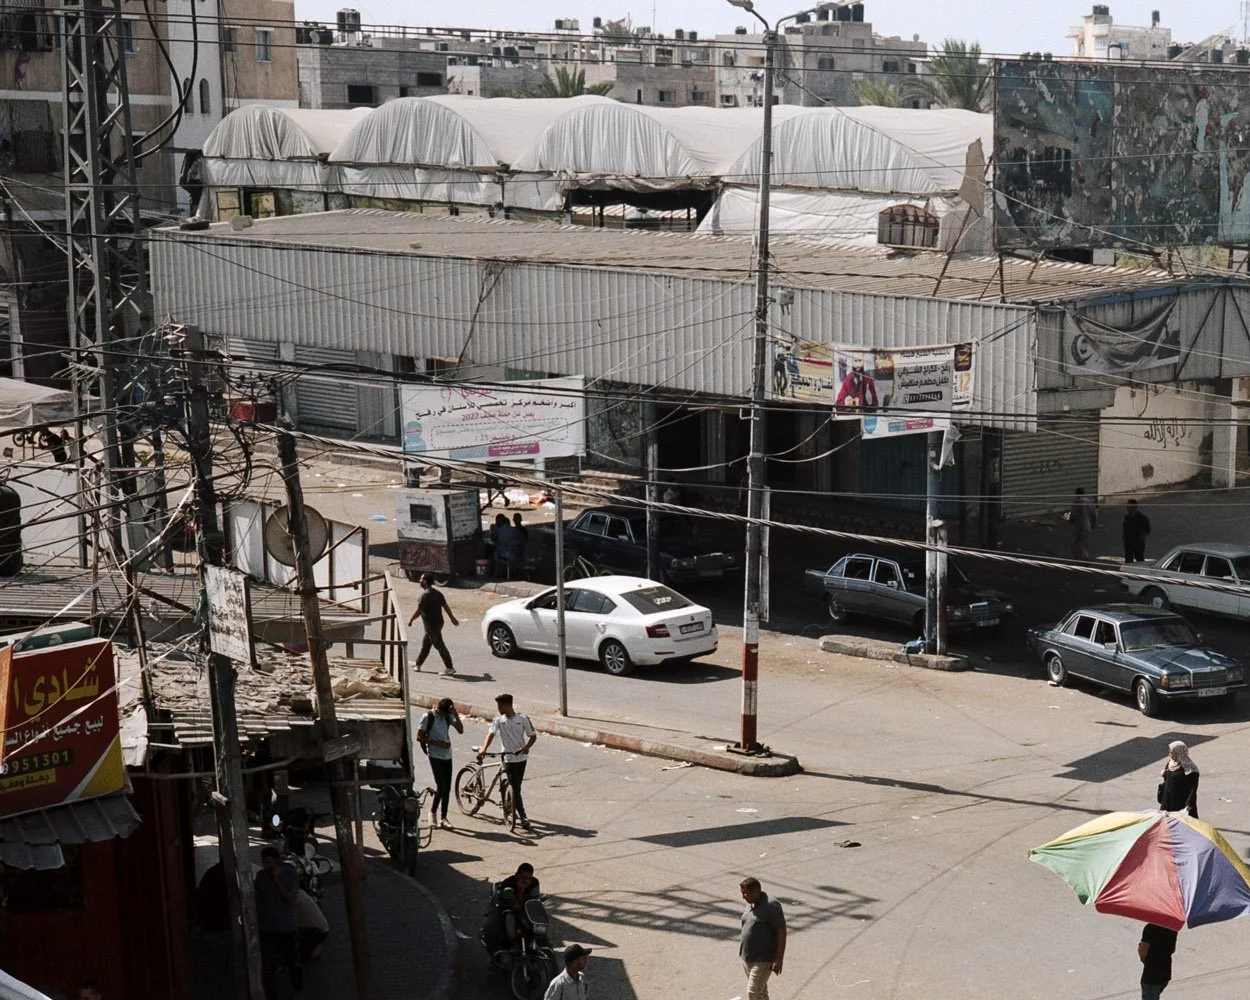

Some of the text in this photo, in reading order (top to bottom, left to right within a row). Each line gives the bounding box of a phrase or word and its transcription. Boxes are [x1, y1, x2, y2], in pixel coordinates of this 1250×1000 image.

[24, 657, 99, 723] شادي
[52, 723, 81, 742] جميع
[84, 715, 104, 735] لبيع
[5, 732, 22, 746] الس
